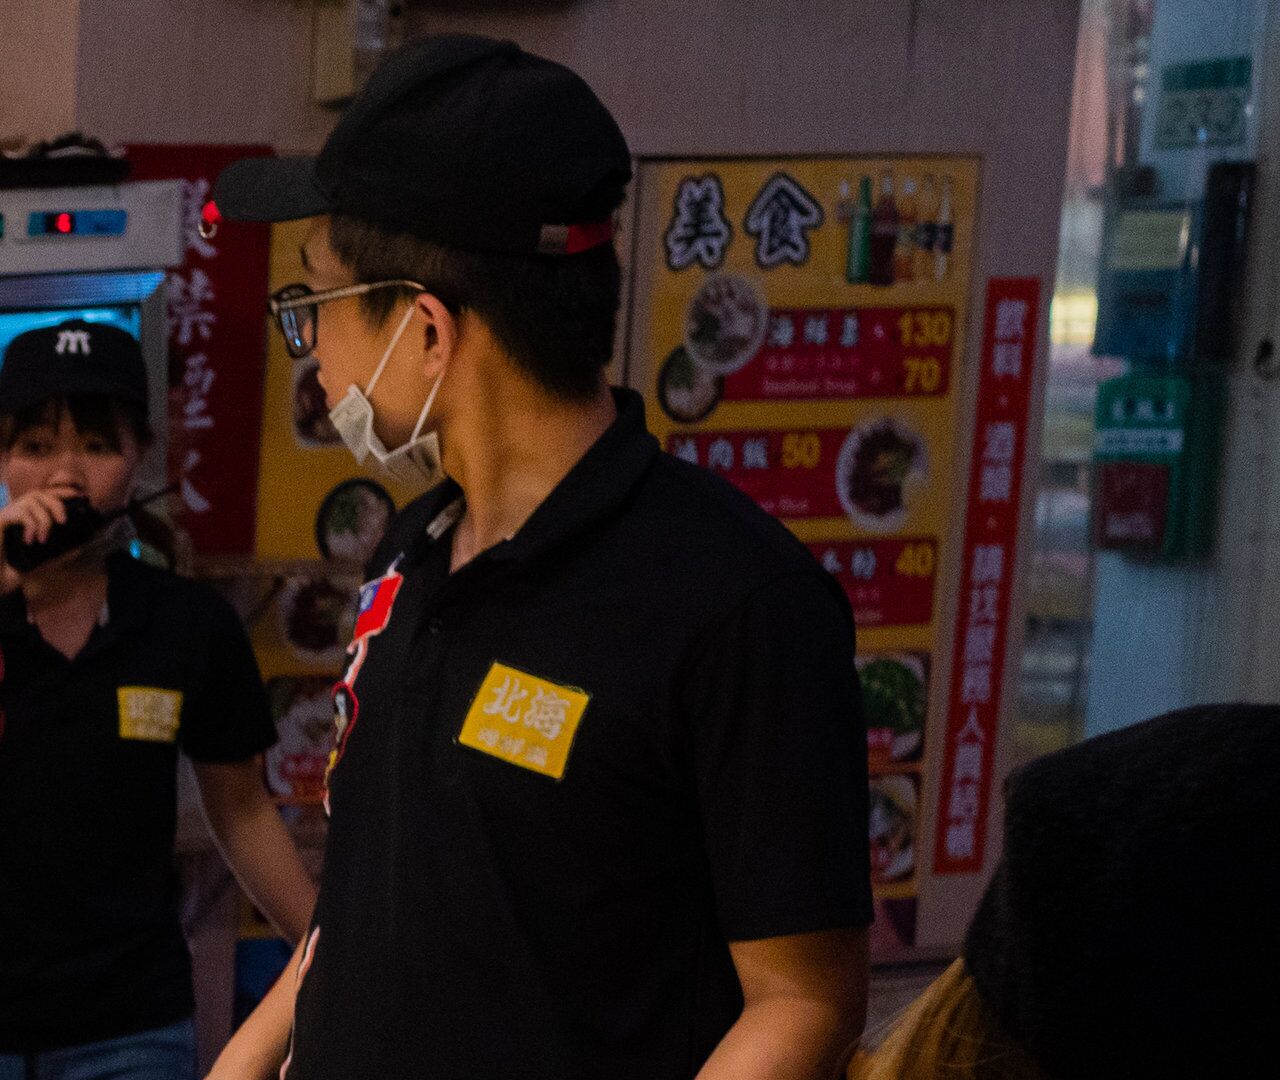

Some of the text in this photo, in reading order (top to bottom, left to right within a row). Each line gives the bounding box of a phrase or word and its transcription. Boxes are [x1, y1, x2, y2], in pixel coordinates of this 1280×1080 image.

[666, 172, 824, 270] 美食
[898, 311, 953, 348] 130
[904, 355, 942, 393] 70
[781, 433, 822, 470] 50
[896, 543, 933, 577] 40
